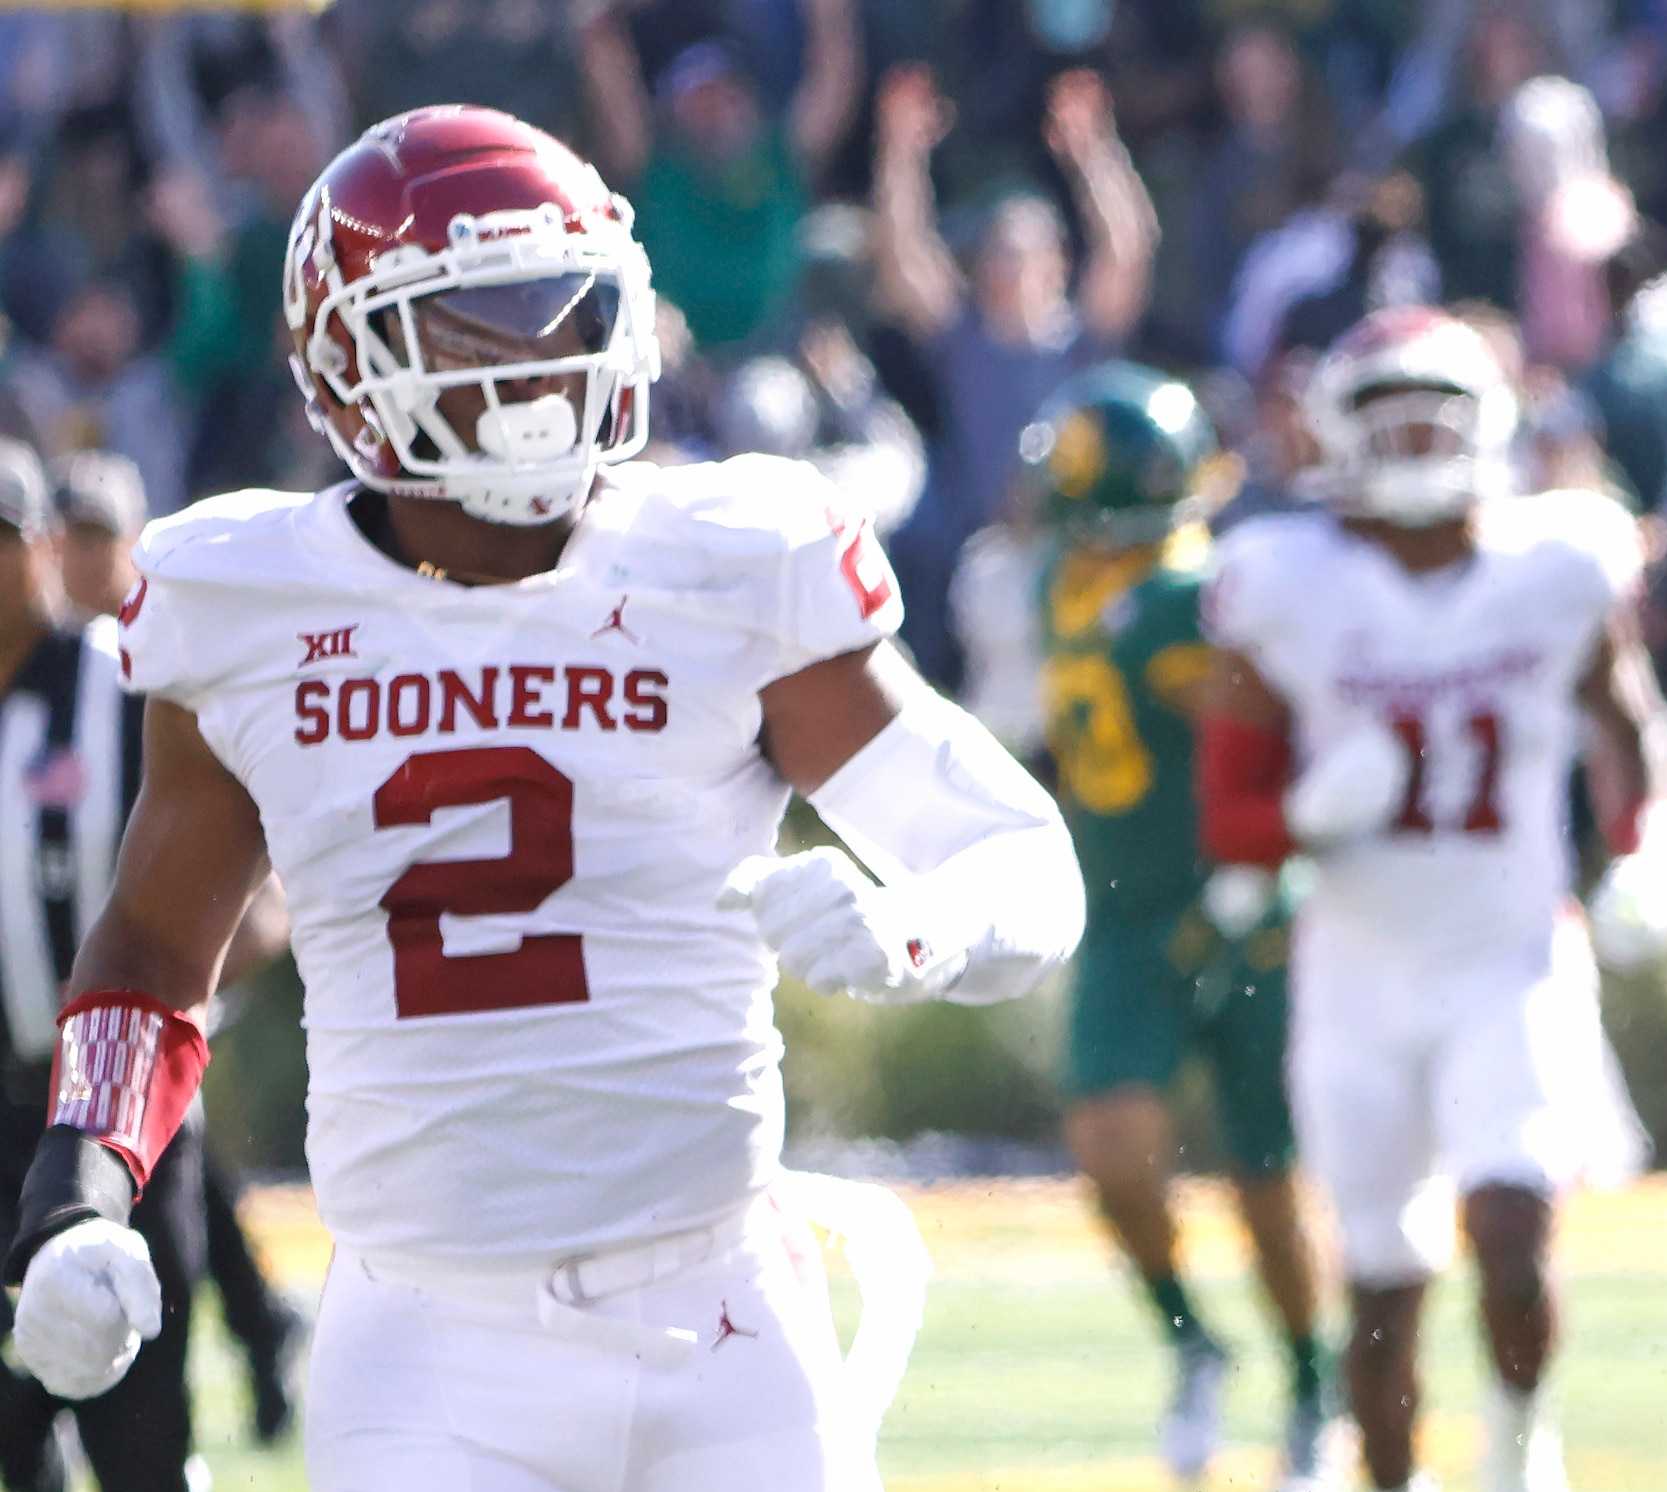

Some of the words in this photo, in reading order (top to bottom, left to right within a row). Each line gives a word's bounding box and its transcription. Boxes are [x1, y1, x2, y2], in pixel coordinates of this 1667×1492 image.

[296, 622, 360, 669] XII
[294, 664, 670, 747] SOONERS
[1389, 706, 1505, 835] 11
[372, 745, 592, 1021] 2
